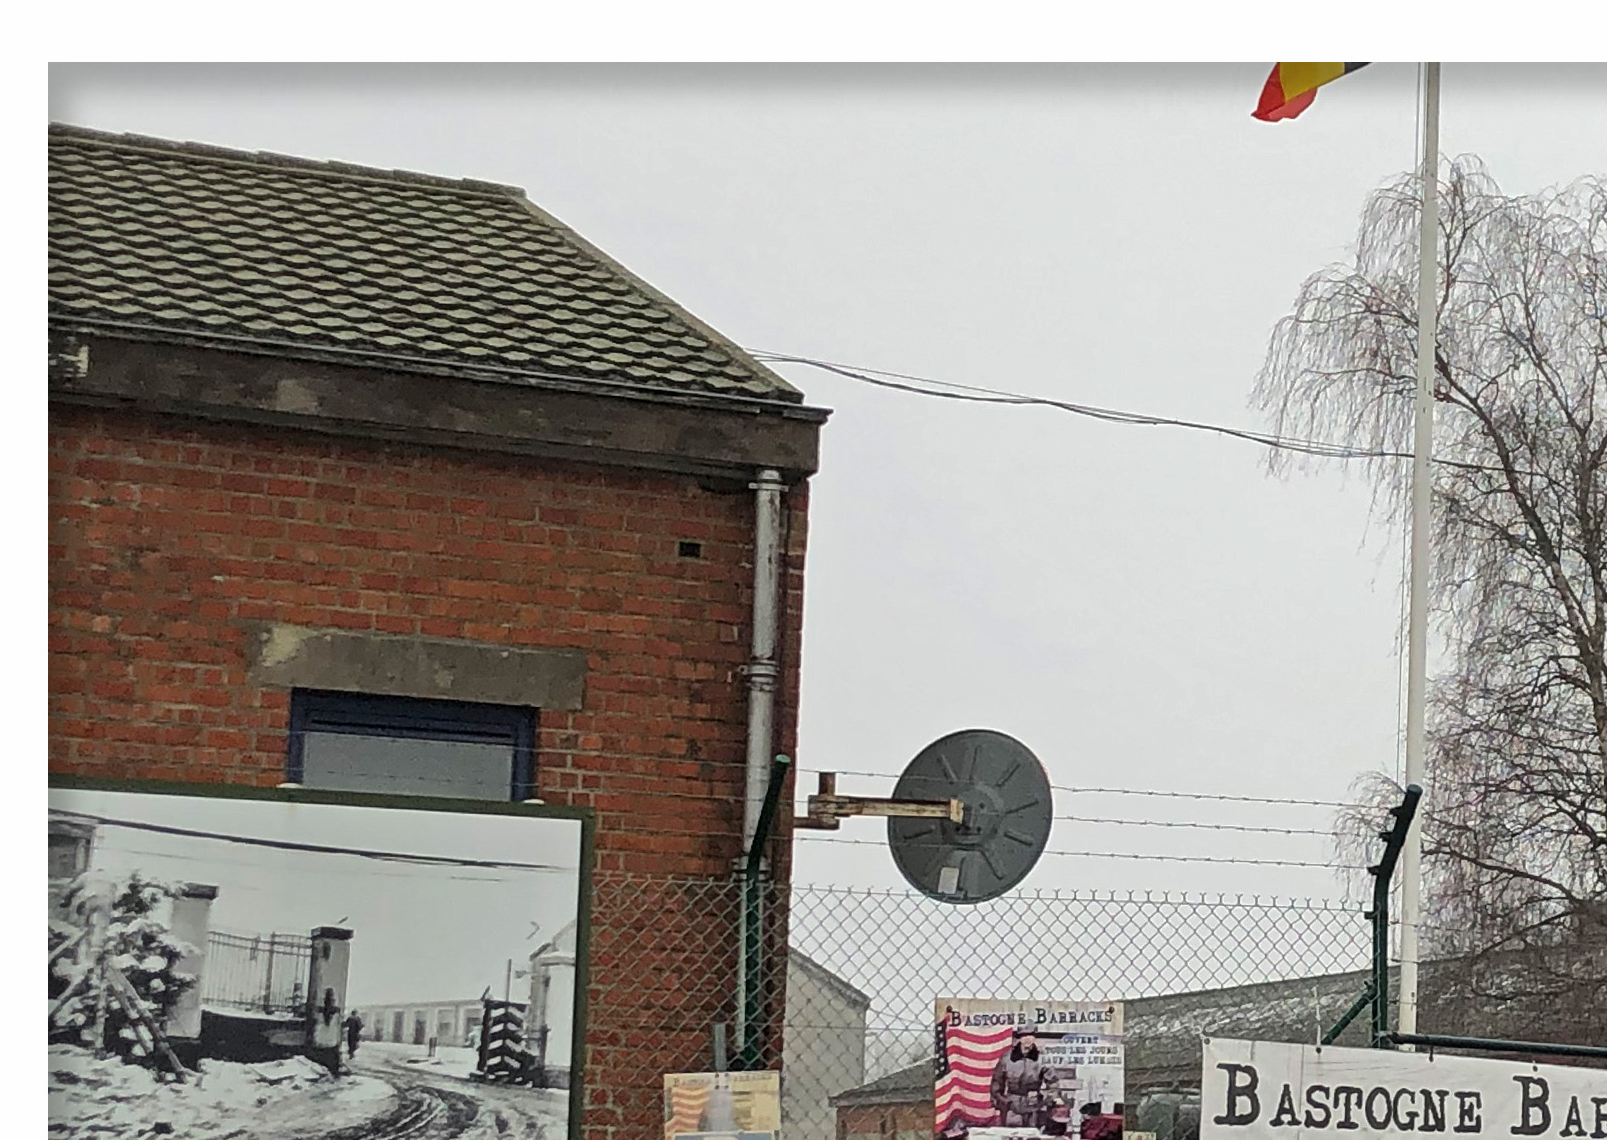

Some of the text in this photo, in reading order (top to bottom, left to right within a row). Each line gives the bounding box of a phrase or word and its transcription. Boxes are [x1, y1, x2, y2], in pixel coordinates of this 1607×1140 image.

[949, 1007, 1114, 1027] BASTOGNE BARRACKS
[1213, 1062, 1483, 1134] BASTOGNE
